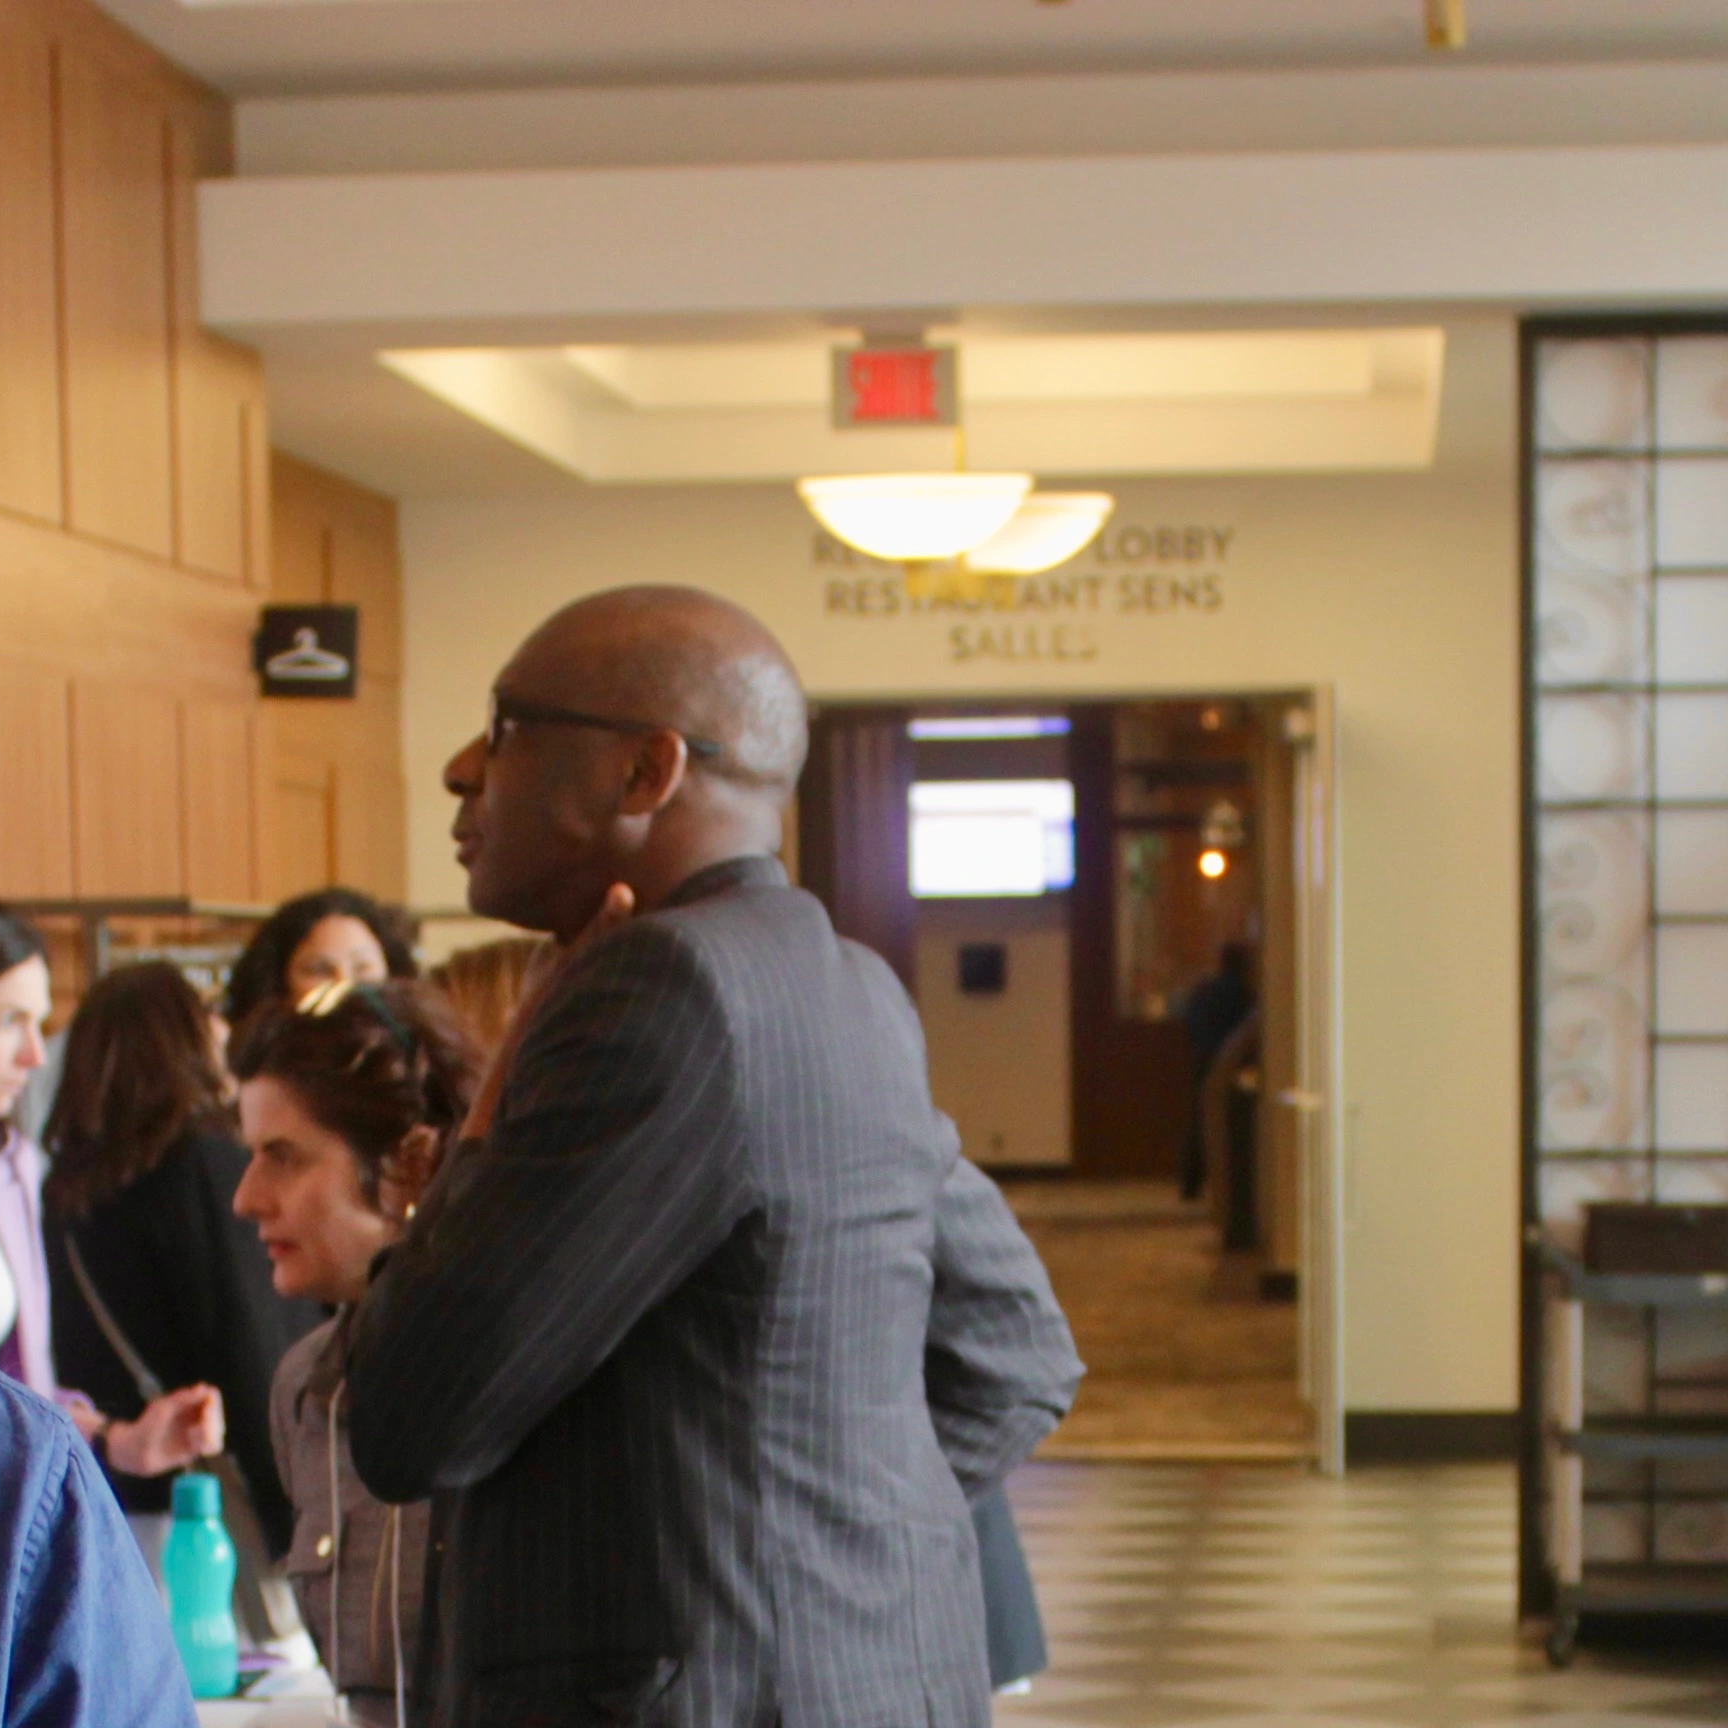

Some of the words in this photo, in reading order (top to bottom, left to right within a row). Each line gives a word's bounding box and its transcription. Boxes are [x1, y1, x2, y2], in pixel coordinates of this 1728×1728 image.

[1094, 525, 1234, 566] LOBBY
[824, 574, 1108, 616] RESAANT
[1118, 574, 1222, 613] SENS
